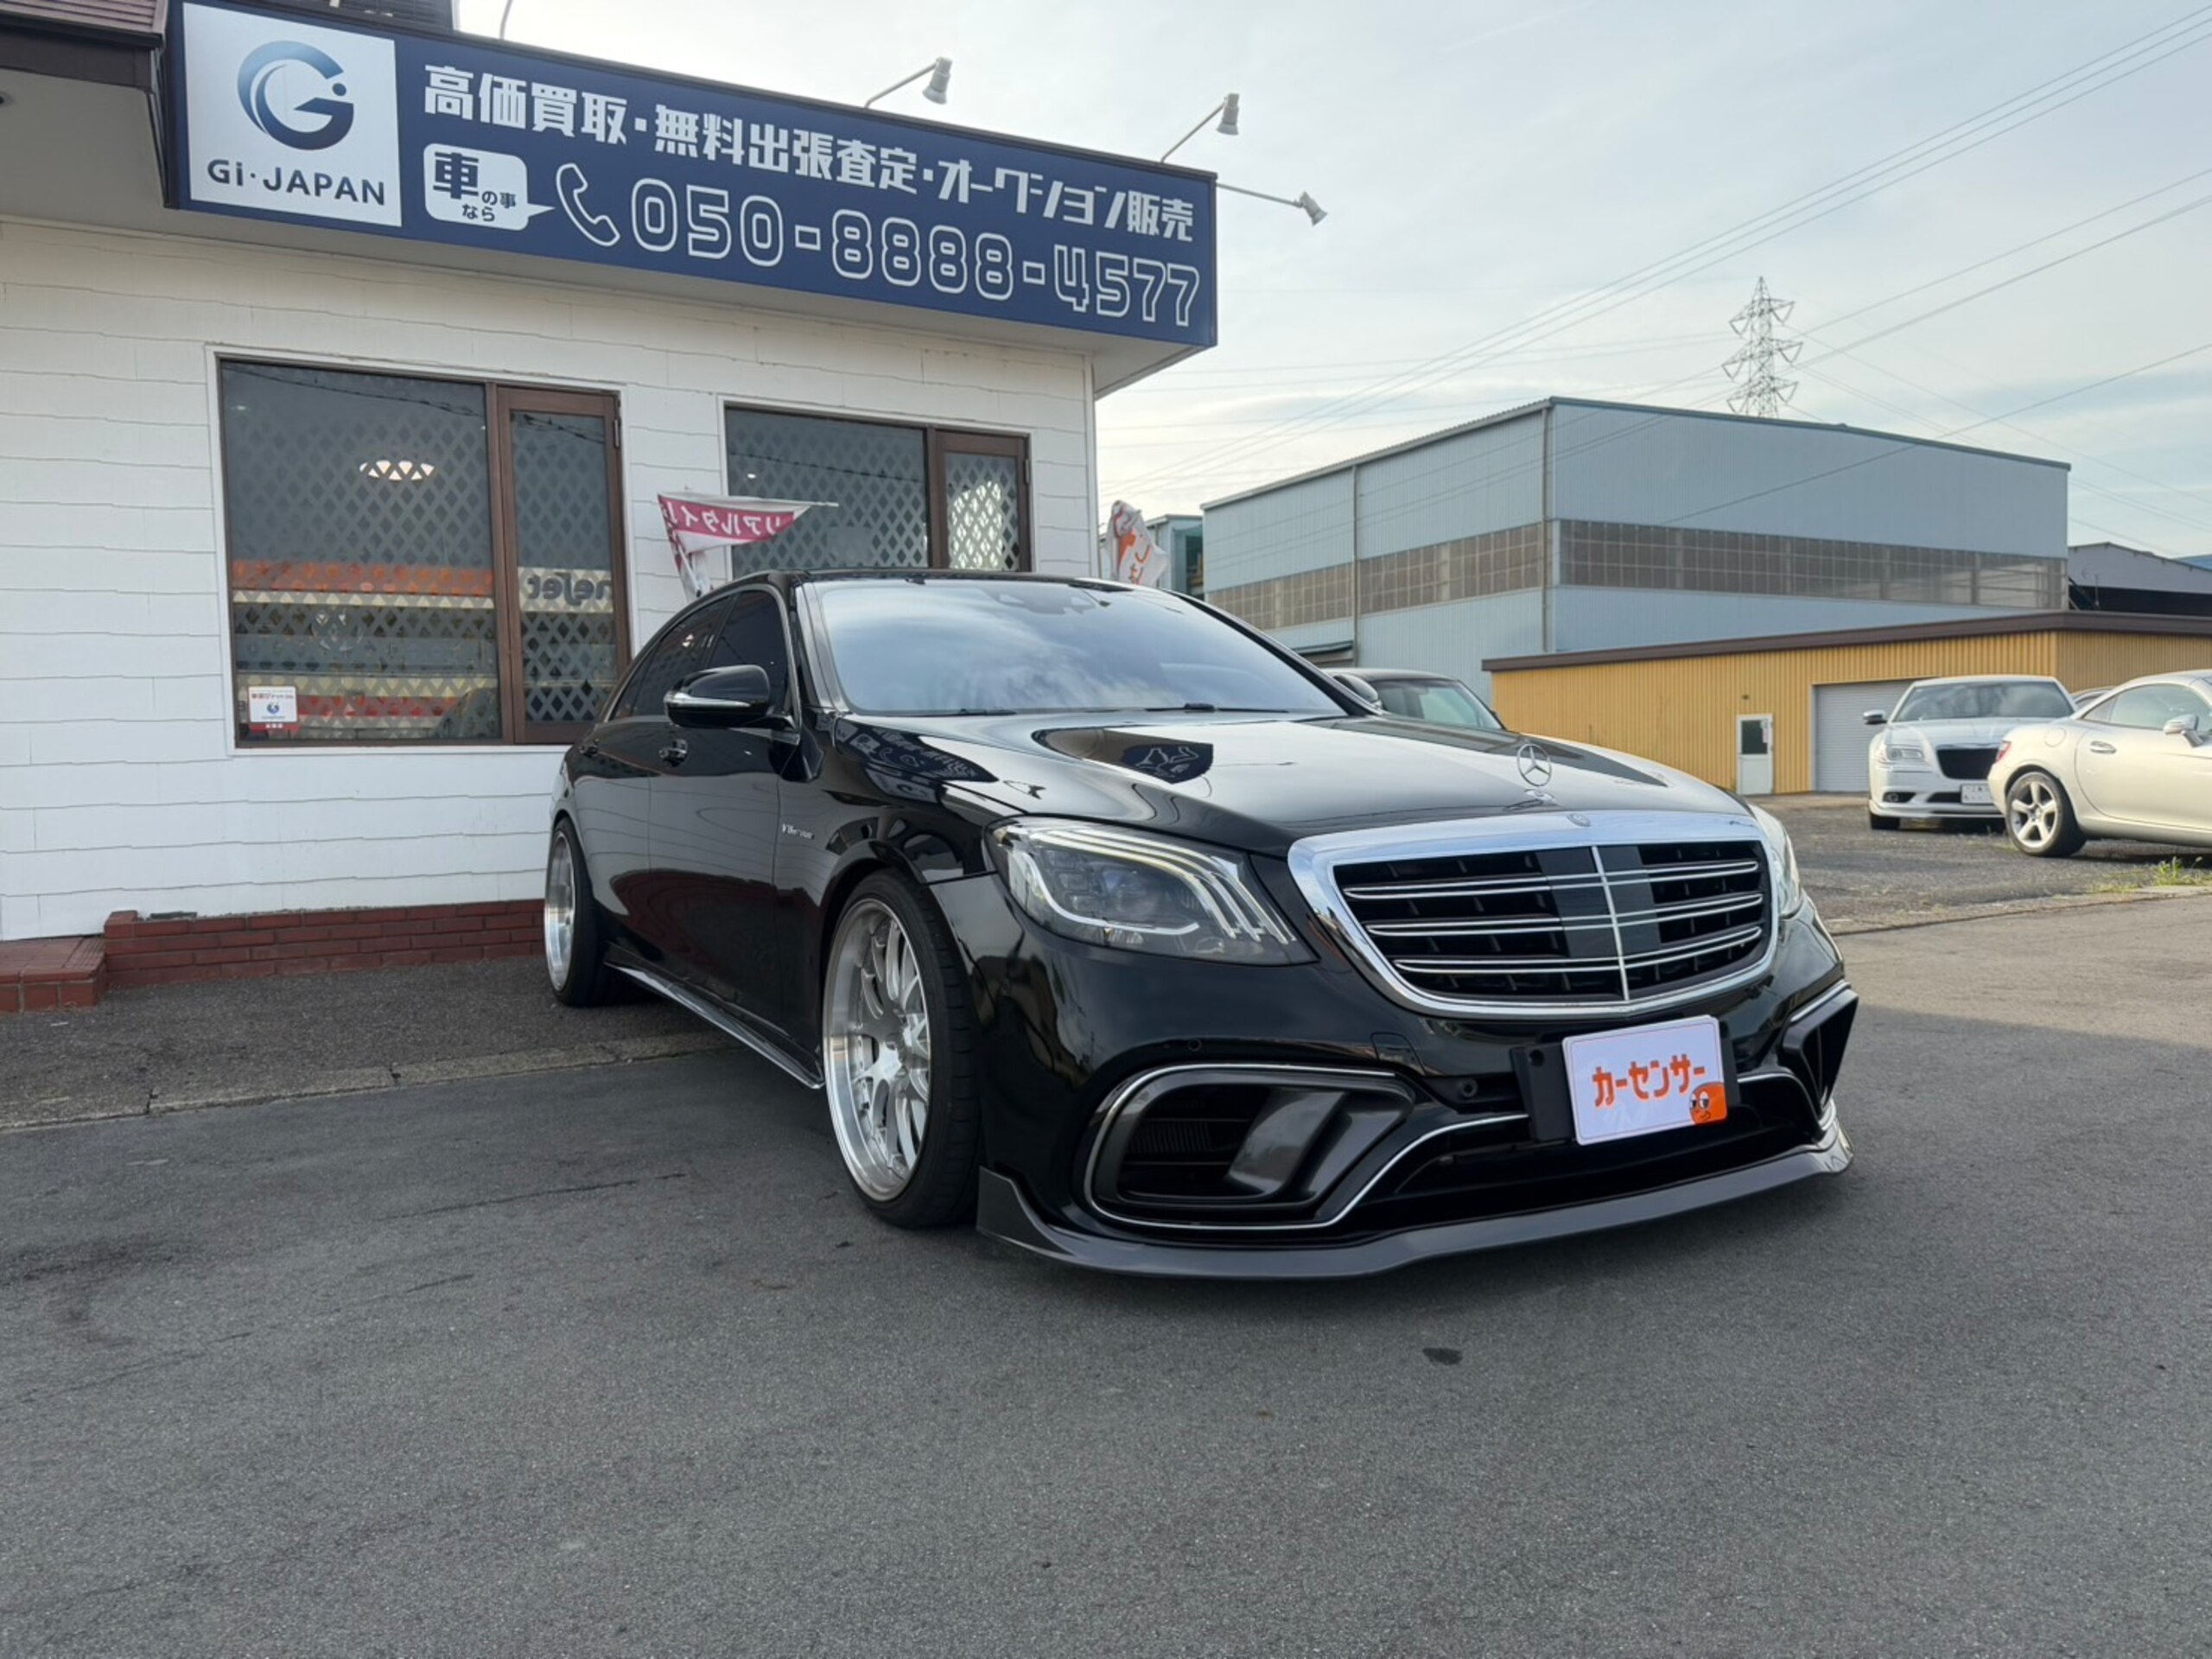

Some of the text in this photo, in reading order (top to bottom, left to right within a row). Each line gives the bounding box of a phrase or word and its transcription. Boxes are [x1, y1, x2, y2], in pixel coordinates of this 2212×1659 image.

[461, 203, 496, 223] なら
[630, 177, 1201, 327] 050-8888-4577
[1592, 1053, 1707, 1109] カーセンサー
